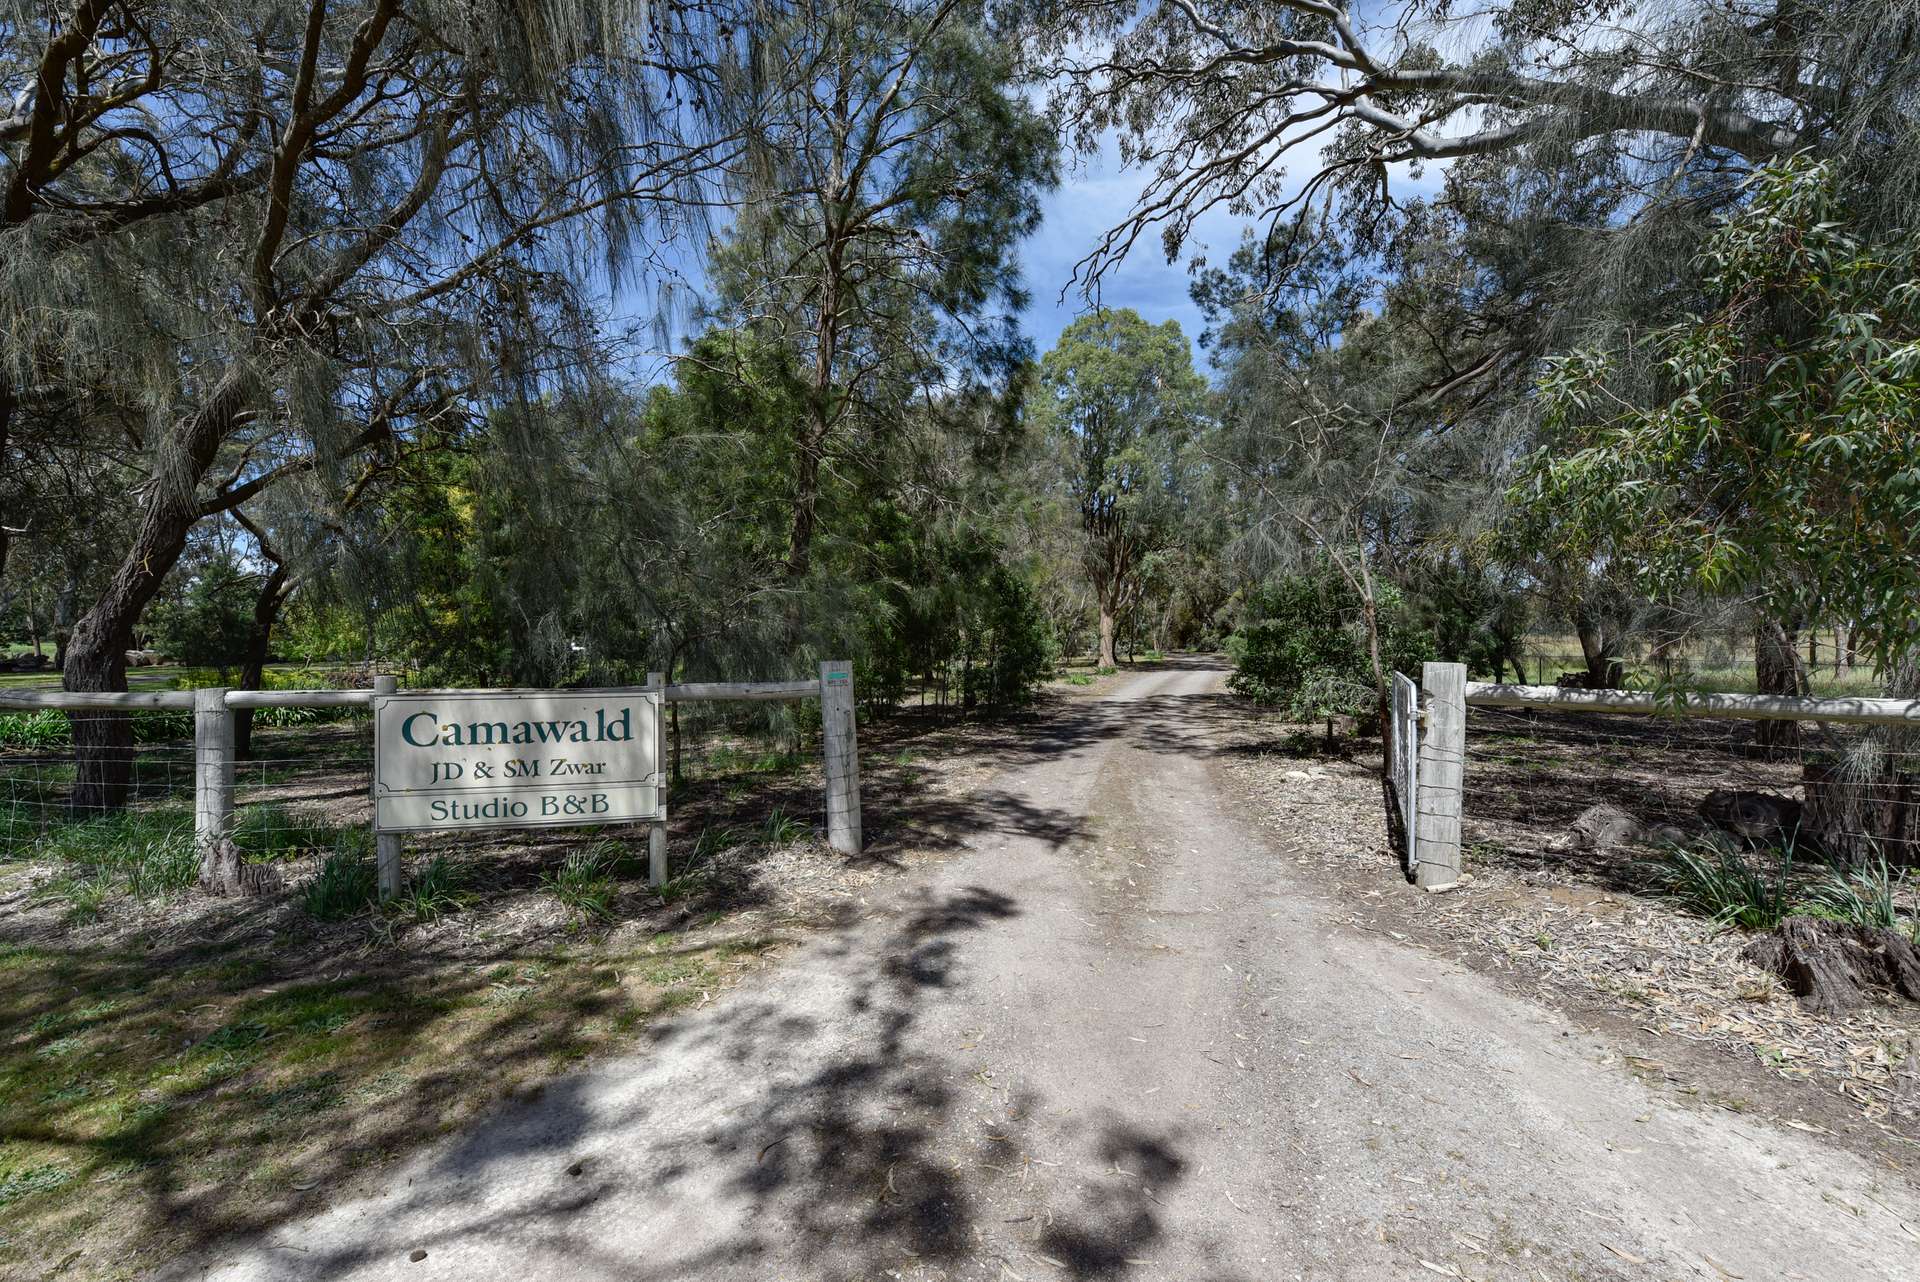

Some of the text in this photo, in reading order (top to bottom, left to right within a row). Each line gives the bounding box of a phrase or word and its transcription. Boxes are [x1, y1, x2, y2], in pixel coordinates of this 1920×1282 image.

[402, 708, 634, 747] Camawald
[430, 758, 606, 784] JD & SM Zwar
[431, 794, 610, 821] Studio B&B
